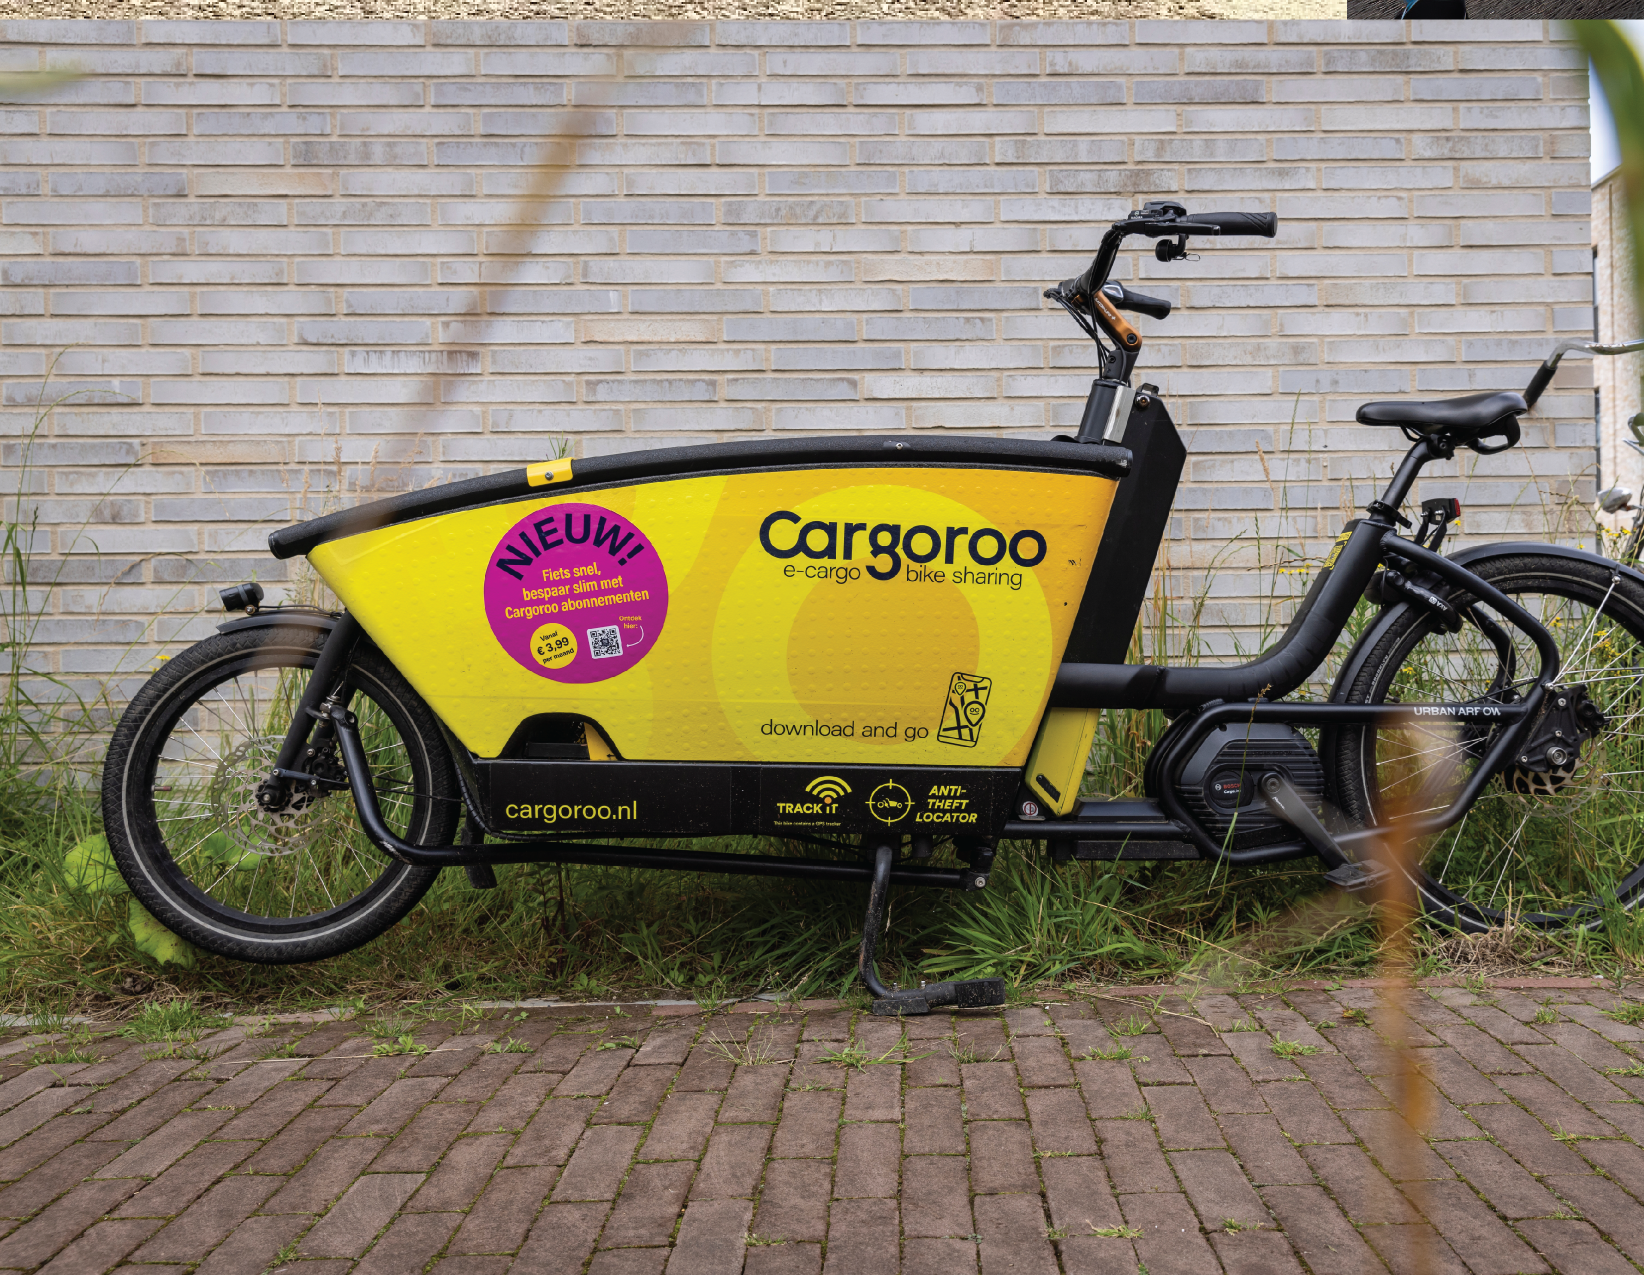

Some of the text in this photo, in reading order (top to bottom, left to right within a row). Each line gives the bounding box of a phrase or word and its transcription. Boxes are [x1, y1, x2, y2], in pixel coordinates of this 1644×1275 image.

[495, 513, 645, 582] NIEUW!
[759, 510, 1048, 581] Cargoroo
[542, 561, 602, 582] Fiets snel,
[783, 563, 1023, 591] e-cargo bike sharing
[522, 575, 624, 601] bespaar slim met
[505, 589, 650, 620] Cargoroo abonnementen
[536, 636, 570, 656] € 3,99
[1413, 706, 1456, 716] URBAN
[761, 719, 930, 742] download and go
[929, 785, 967, 796] ANTI-
[505, 800, 637, 824] cargoroo.nl
[776, 803, 823, 814] TRACK
[927, 799, 970, 810] THEFT
[915, 812, 978, 823] LOCATOR
